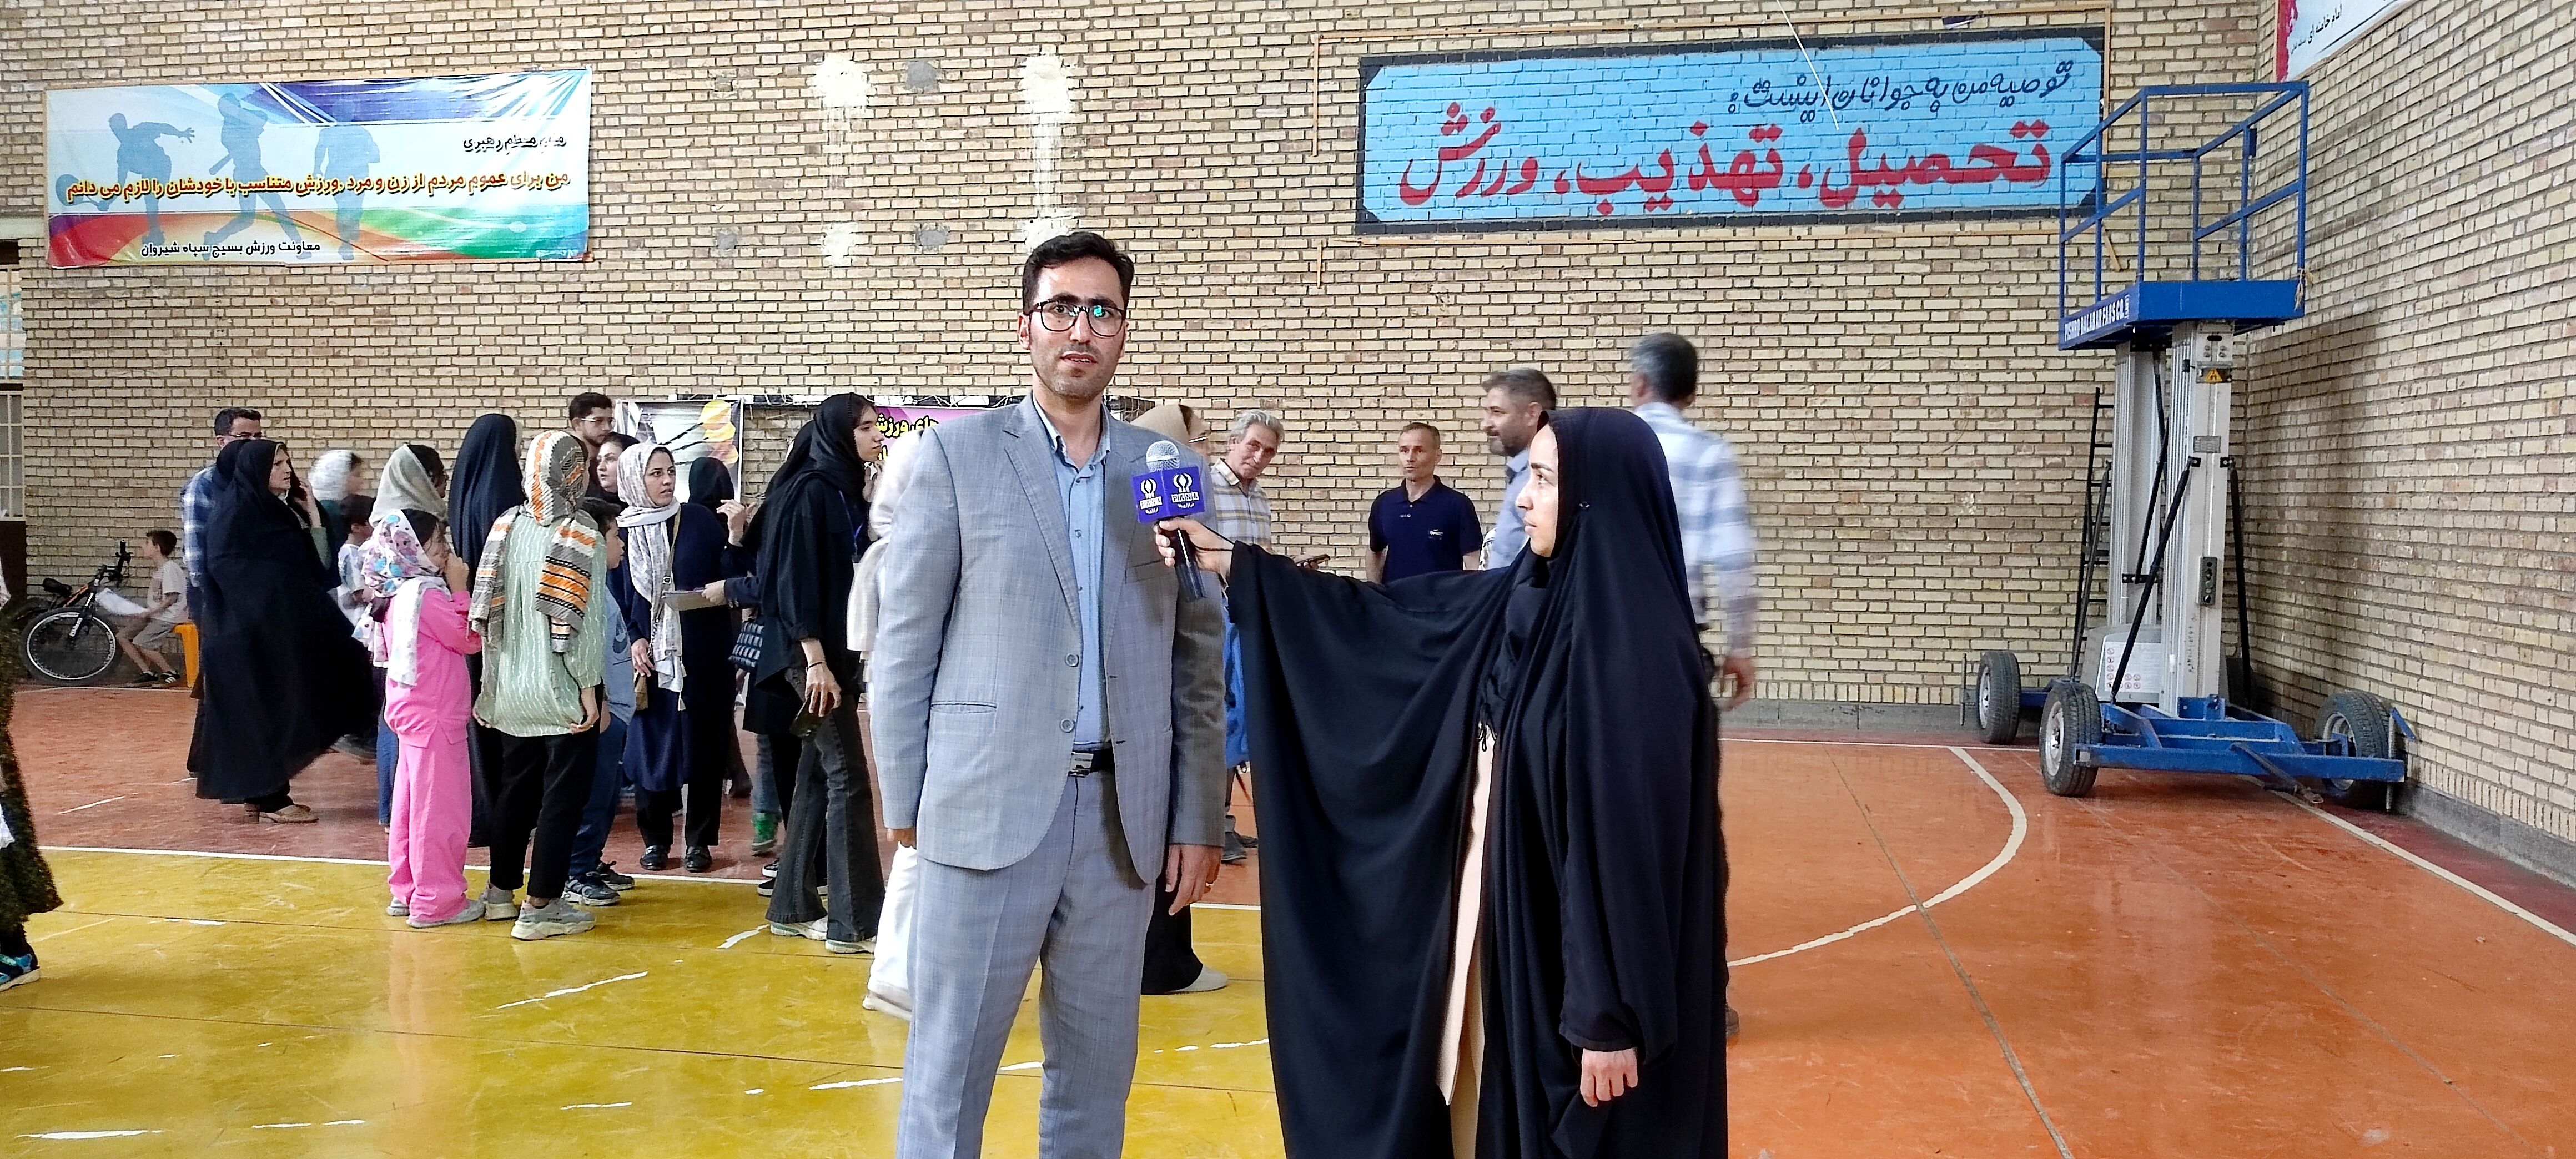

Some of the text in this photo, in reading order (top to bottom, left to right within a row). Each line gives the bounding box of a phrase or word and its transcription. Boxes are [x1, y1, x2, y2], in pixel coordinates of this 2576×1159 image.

[1832, 75, 1924, 112] جوانان
[1951, 80, 1989, 104] من
[1990, 59, 2074, 108] توصیه
[1924, 77, 1949, 113] به
[463, 136, 504, 153] رهبری
[1399, 102, 1539, 206] ورزش
[99, 182, 122, 200] می
[123, 178, 150, 203] لازم
[152, 178, 164, 199] را
[167, 177, 224, 199] خودشان
[225, 177, 237, 198] با
[238, 175, 294, 198] متناسب
[346, 175, 374, 195] مرد
[375, 177, 385, 194] و
[386, 175, 410, 194] زن
[411, 173, 426, 194] از
[427, 175, 466, 197] مردم
[468, 173, 507, 196] عموم
[510, 171, 544, 190] برای
[545, 172, 571, 191] من
[66, 179, 97, 204] دانم
[141, 240, 321, 258] معاونت ورزش بسیج سپاه شیروان
[1140, 496, 1163, 510] PANA
[1172, 492, 1199, 503] PANA
